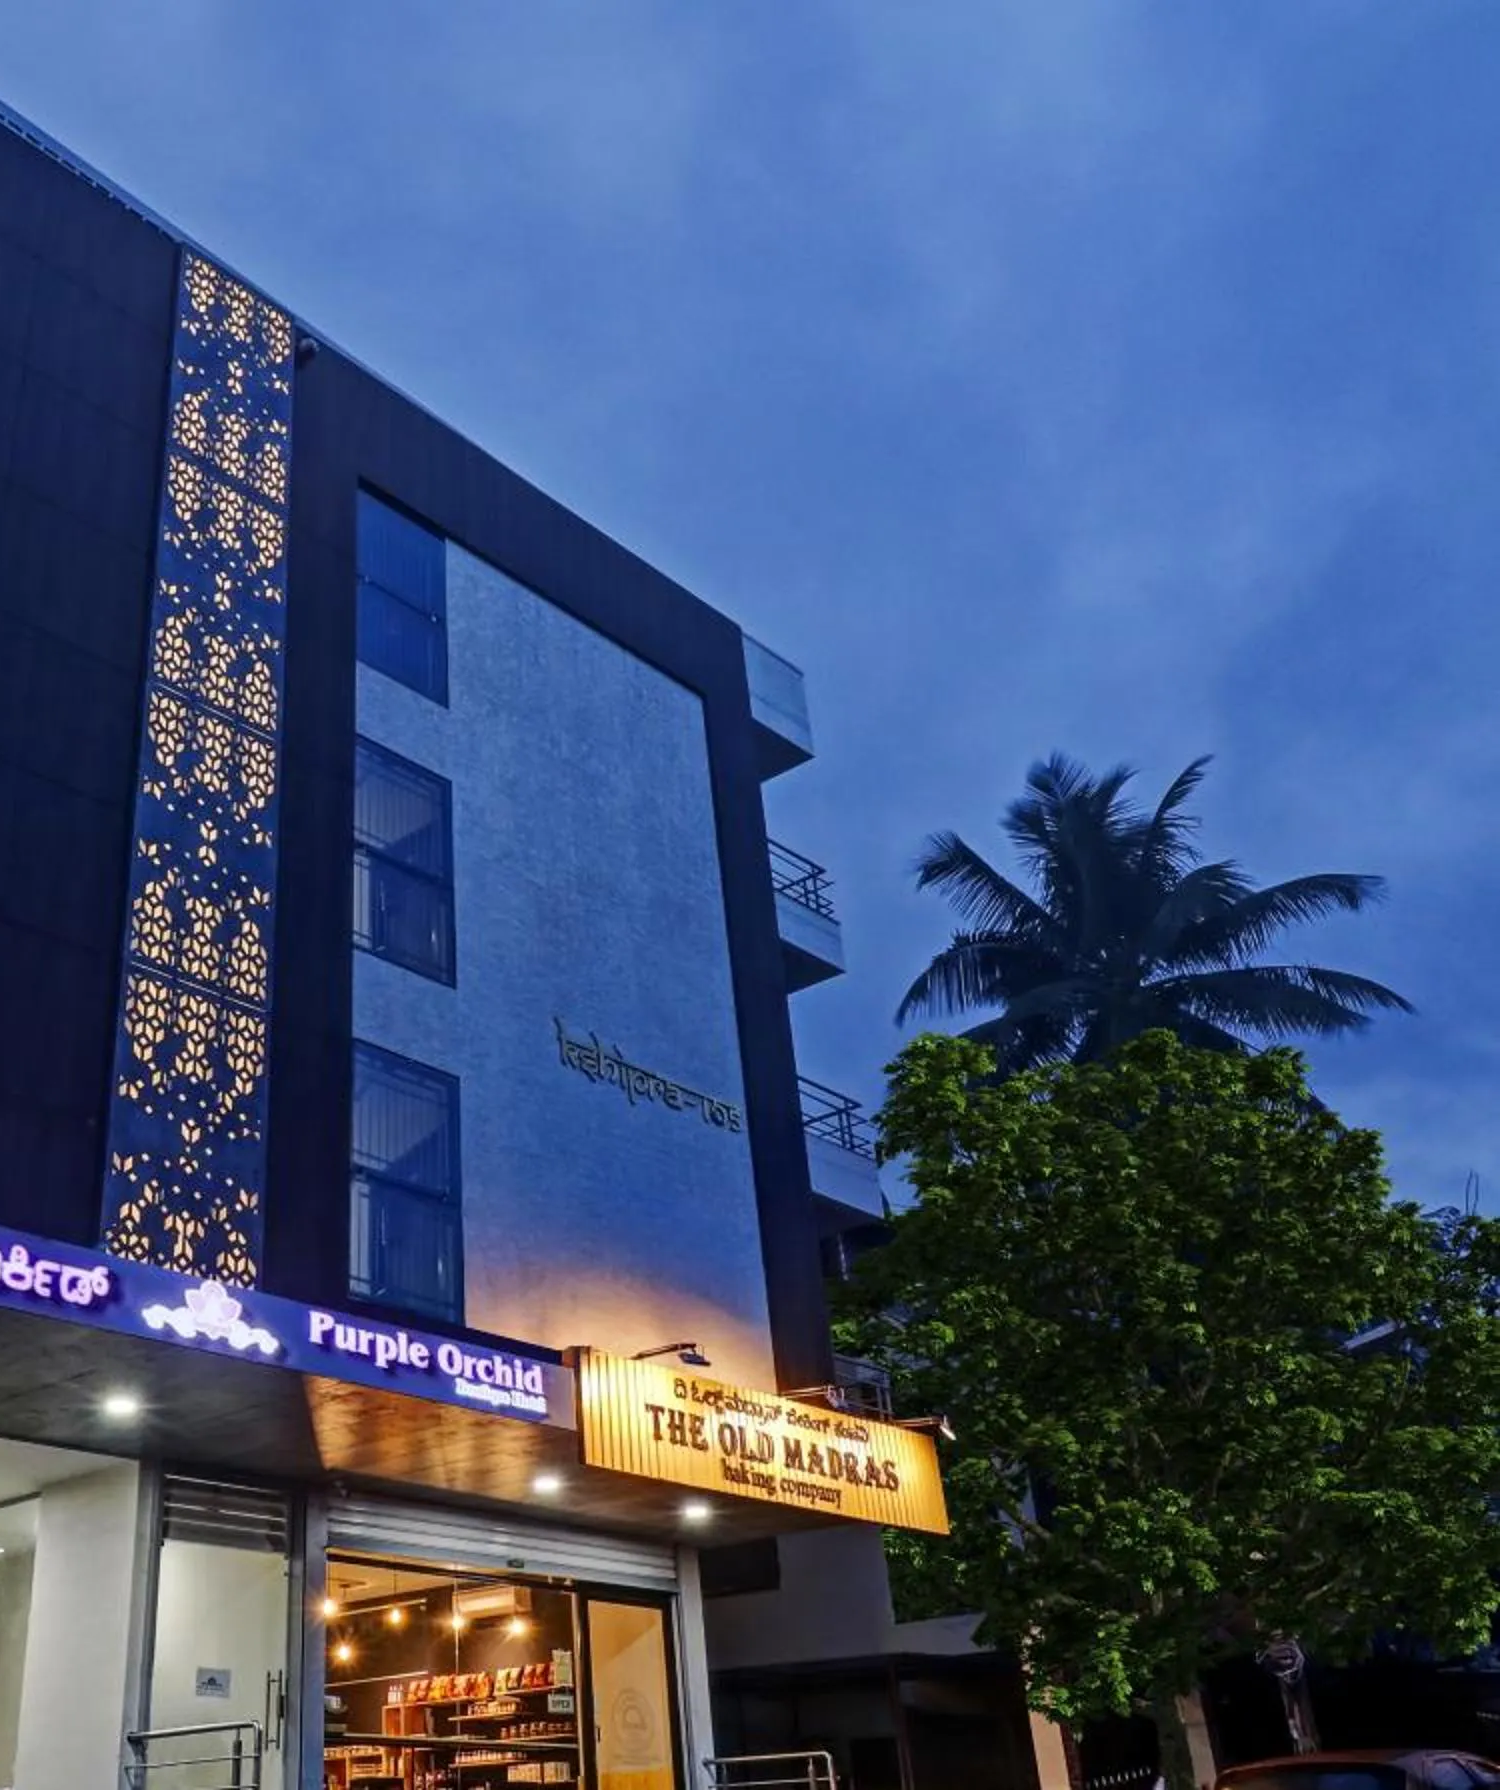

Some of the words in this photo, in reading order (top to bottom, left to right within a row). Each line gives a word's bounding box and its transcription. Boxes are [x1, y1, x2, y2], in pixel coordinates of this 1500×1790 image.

[309, 1310, 430, 1369] Purple
[437, 1343, 544, 1395] Orchid
[645, 1403, 709, 1451] THE
[717, 1422, 775, 1465] OLD
[783, 1435, 899, 1492] MADRAS
[721, 1458, 776, 1496] baking
[780, 1478, 842, 1509] company
